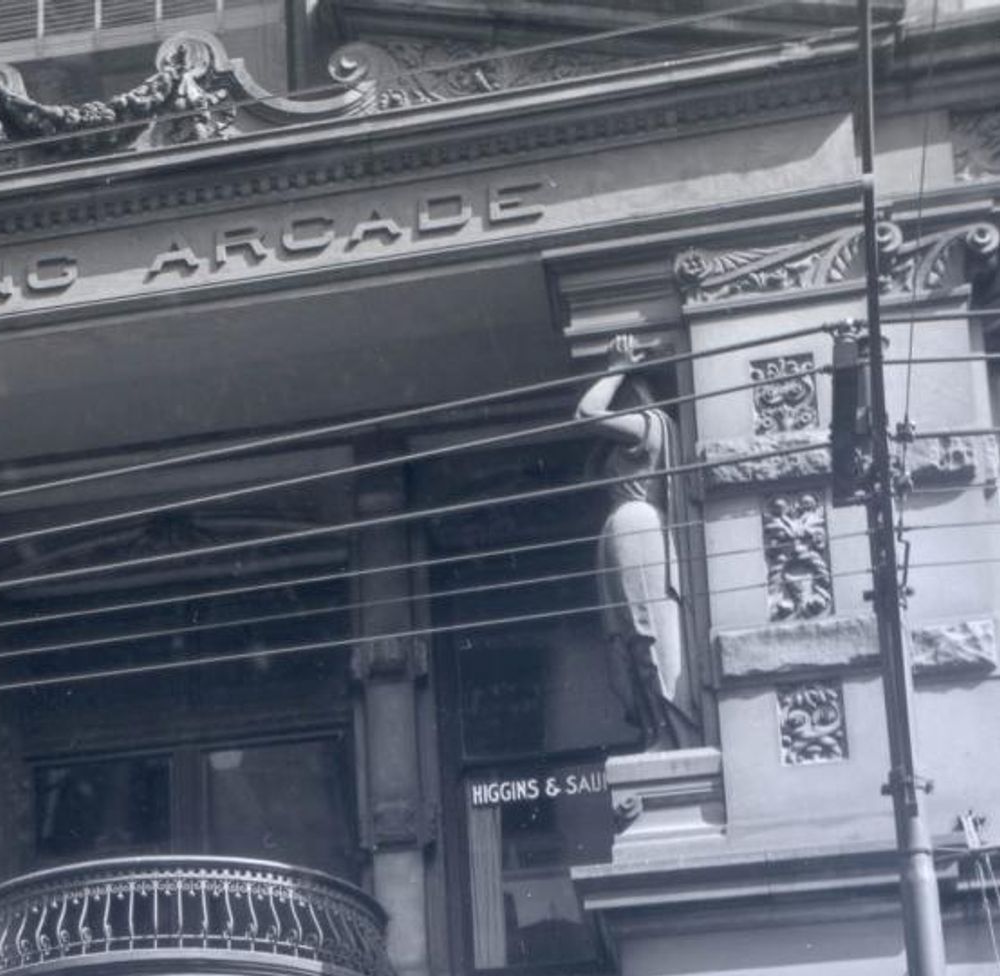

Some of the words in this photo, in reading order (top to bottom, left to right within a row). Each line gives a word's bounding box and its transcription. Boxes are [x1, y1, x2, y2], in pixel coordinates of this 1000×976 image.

[143, 183, 544, 284] ARCADE
[472, 779, 540, 804] HIGGINS
[546, 777, 561, 797] &
